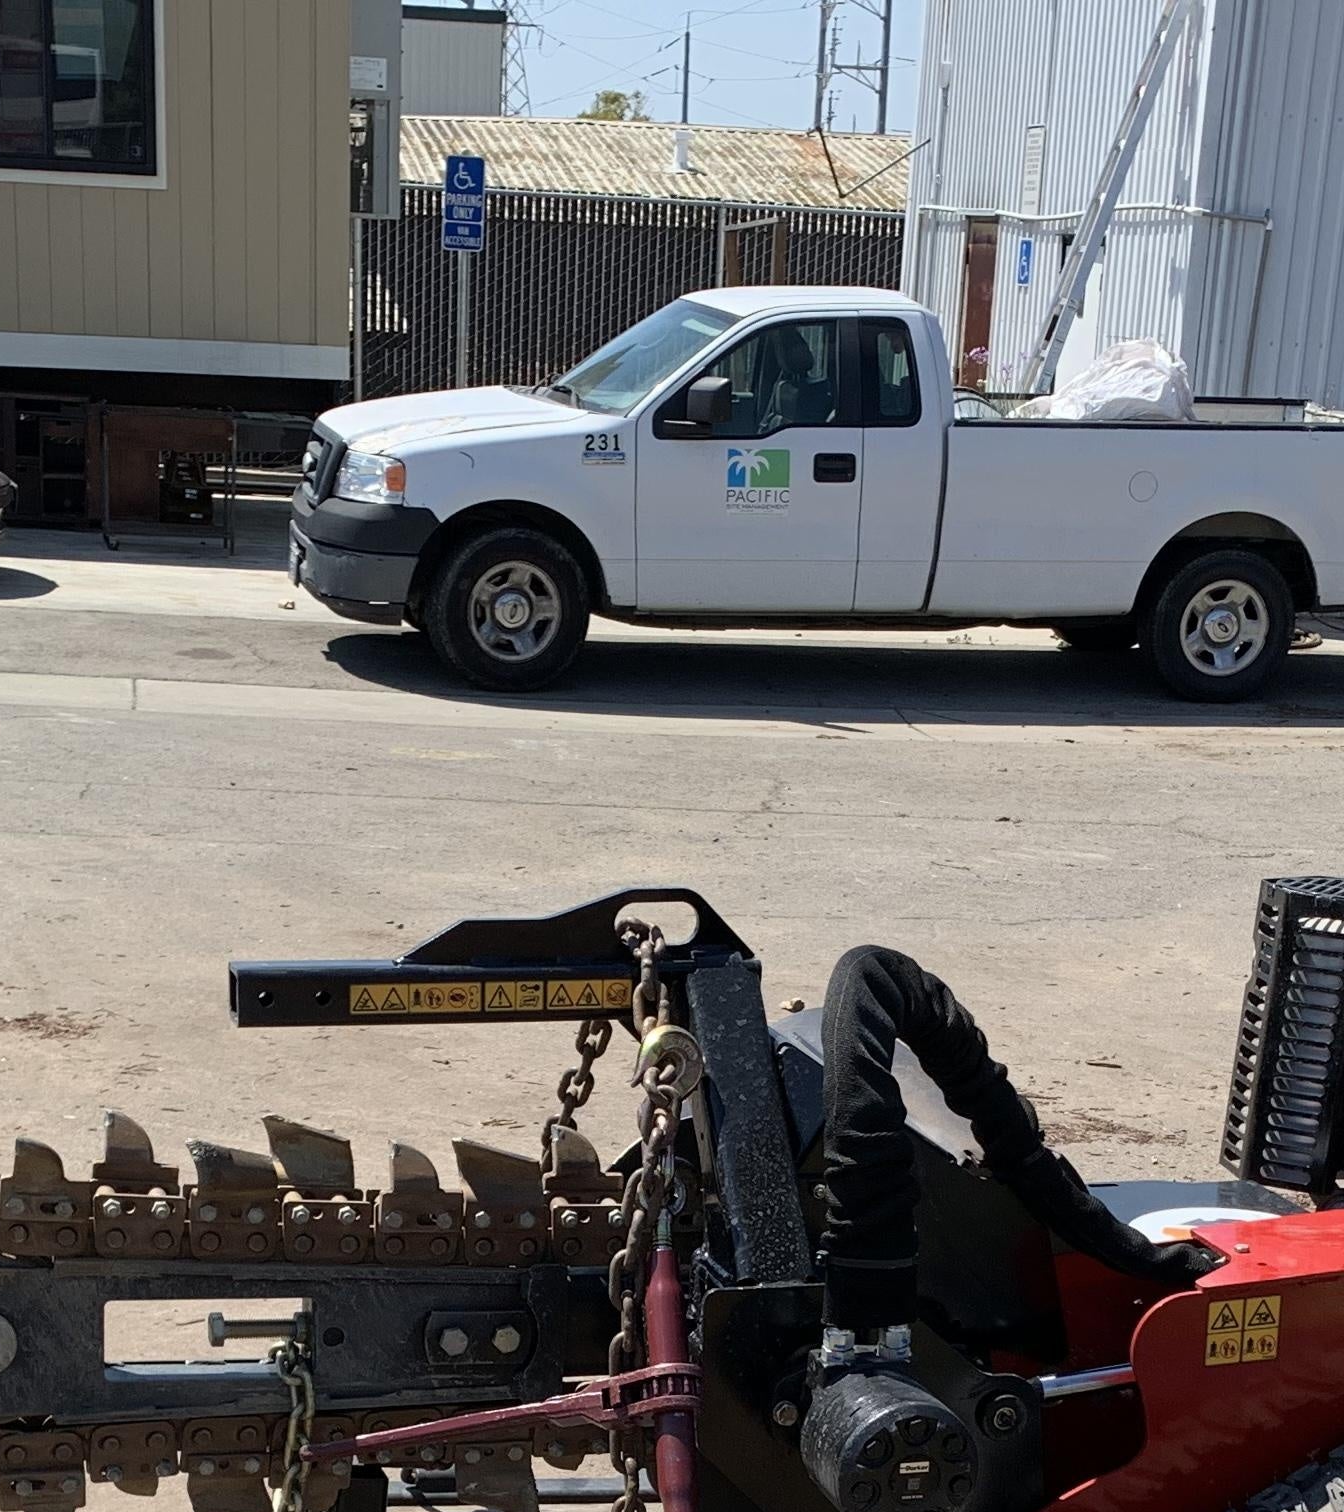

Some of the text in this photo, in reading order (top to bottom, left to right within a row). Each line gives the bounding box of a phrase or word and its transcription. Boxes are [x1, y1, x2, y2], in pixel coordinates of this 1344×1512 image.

[446, 193, 482, 207] PARKING
[452, 206, 474, 219] ONLY
[585, 433, 620, 451] 231
[726, 489, 790, 503] PACIFIC
